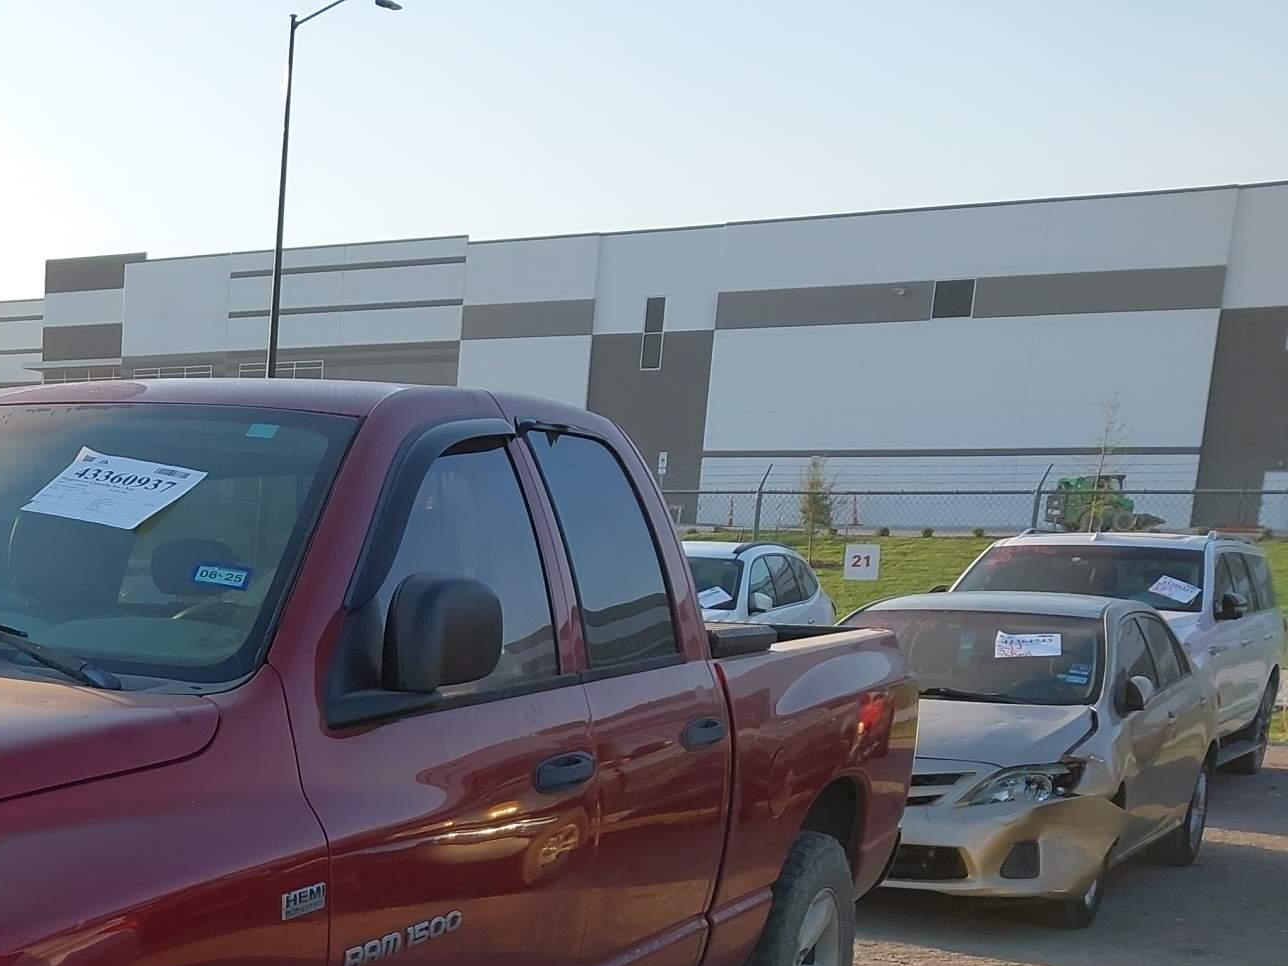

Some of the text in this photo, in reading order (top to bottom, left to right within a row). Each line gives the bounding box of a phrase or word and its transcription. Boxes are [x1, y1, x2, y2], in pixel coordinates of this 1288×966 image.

[74, 467, 178, 493] 43360937
[851, 554, 871, 568] 21
[199, 569, 244, 583] 08 25
[406, 910, 463, 948] 1500
